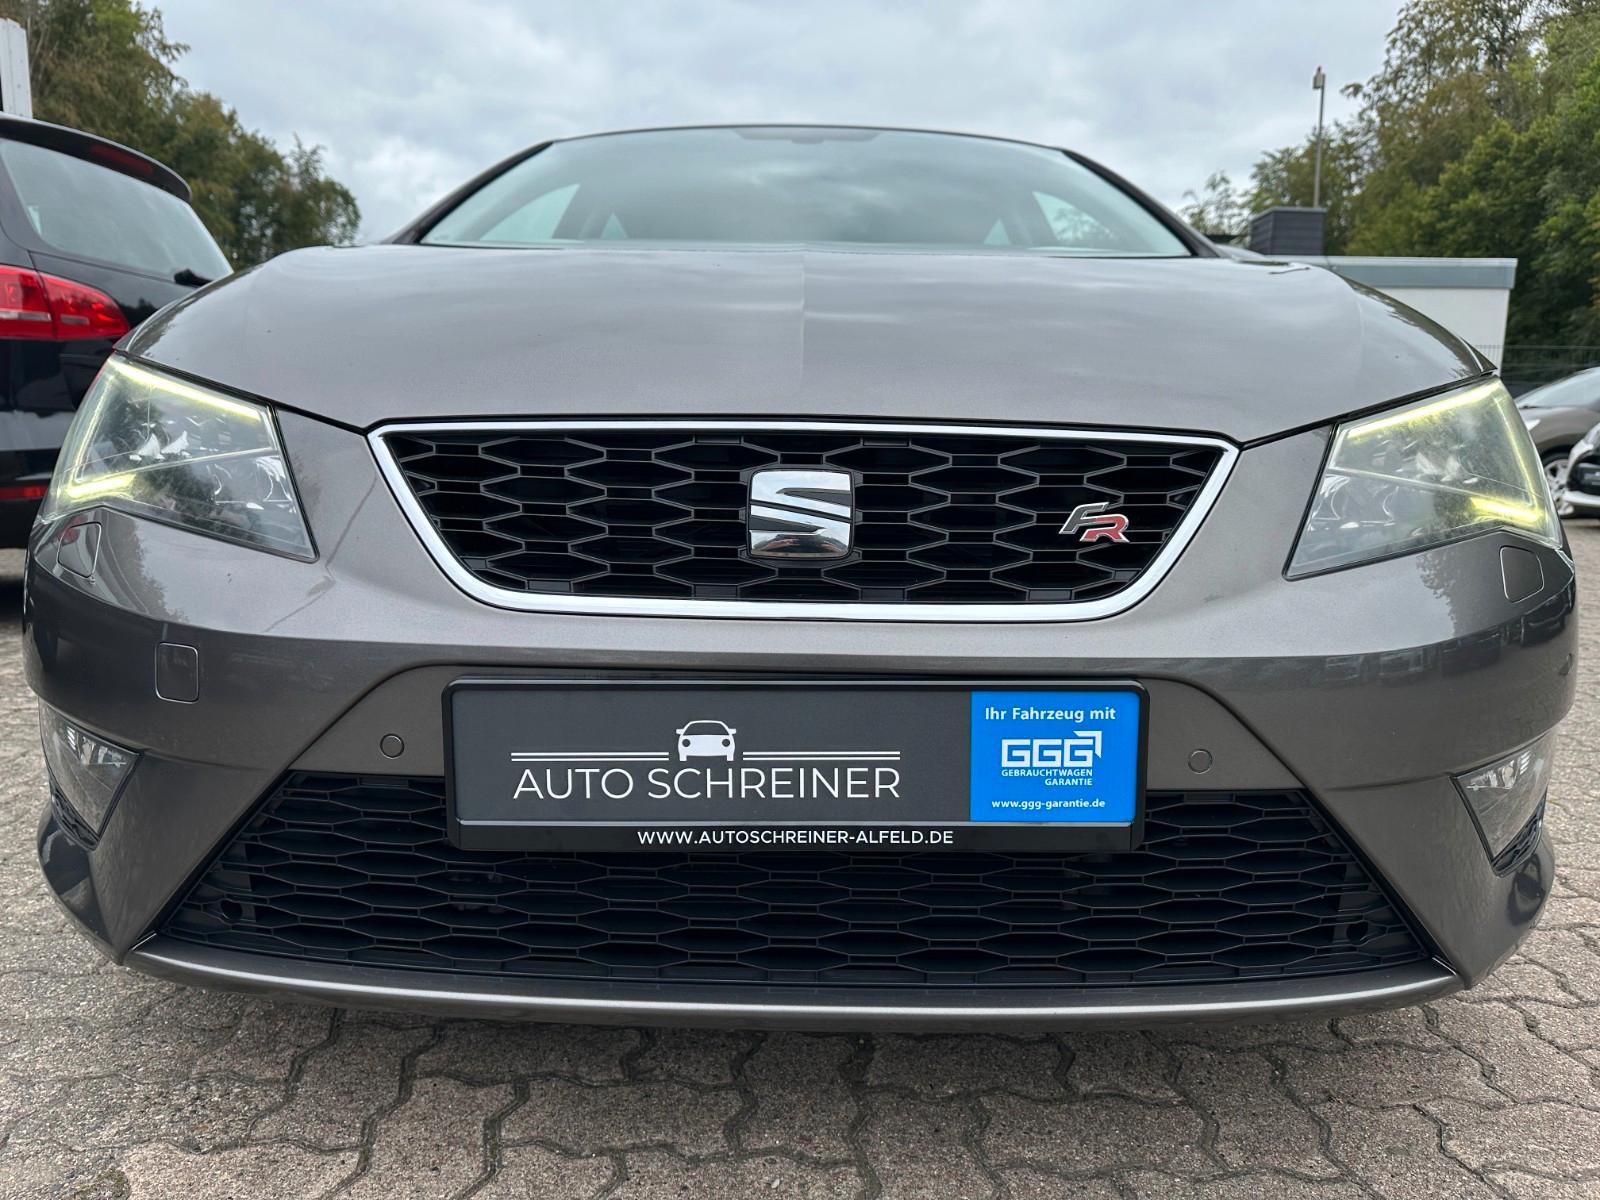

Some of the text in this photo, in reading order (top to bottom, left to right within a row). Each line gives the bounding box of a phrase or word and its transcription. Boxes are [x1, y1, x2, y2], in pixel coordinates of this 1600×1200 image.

[1059, 502, 1130, 542] FR
[985, 707, 1116, 723] Ihr Fahrzeug mit
[1001, 739, 1093, 767] GGG
[1001, 769, 1093, 777] GEBRAUCHTWAGEN
[513, 767, 900, 799] AUTO SCHREINER
[1045, 778, 1093, 786] GARANTIE
[992, 799, 1105, 809] www.ggg-garantie.de
[637, 830, 954, 845] WWW.AUTOSCHREINER-ALFELD.DE
